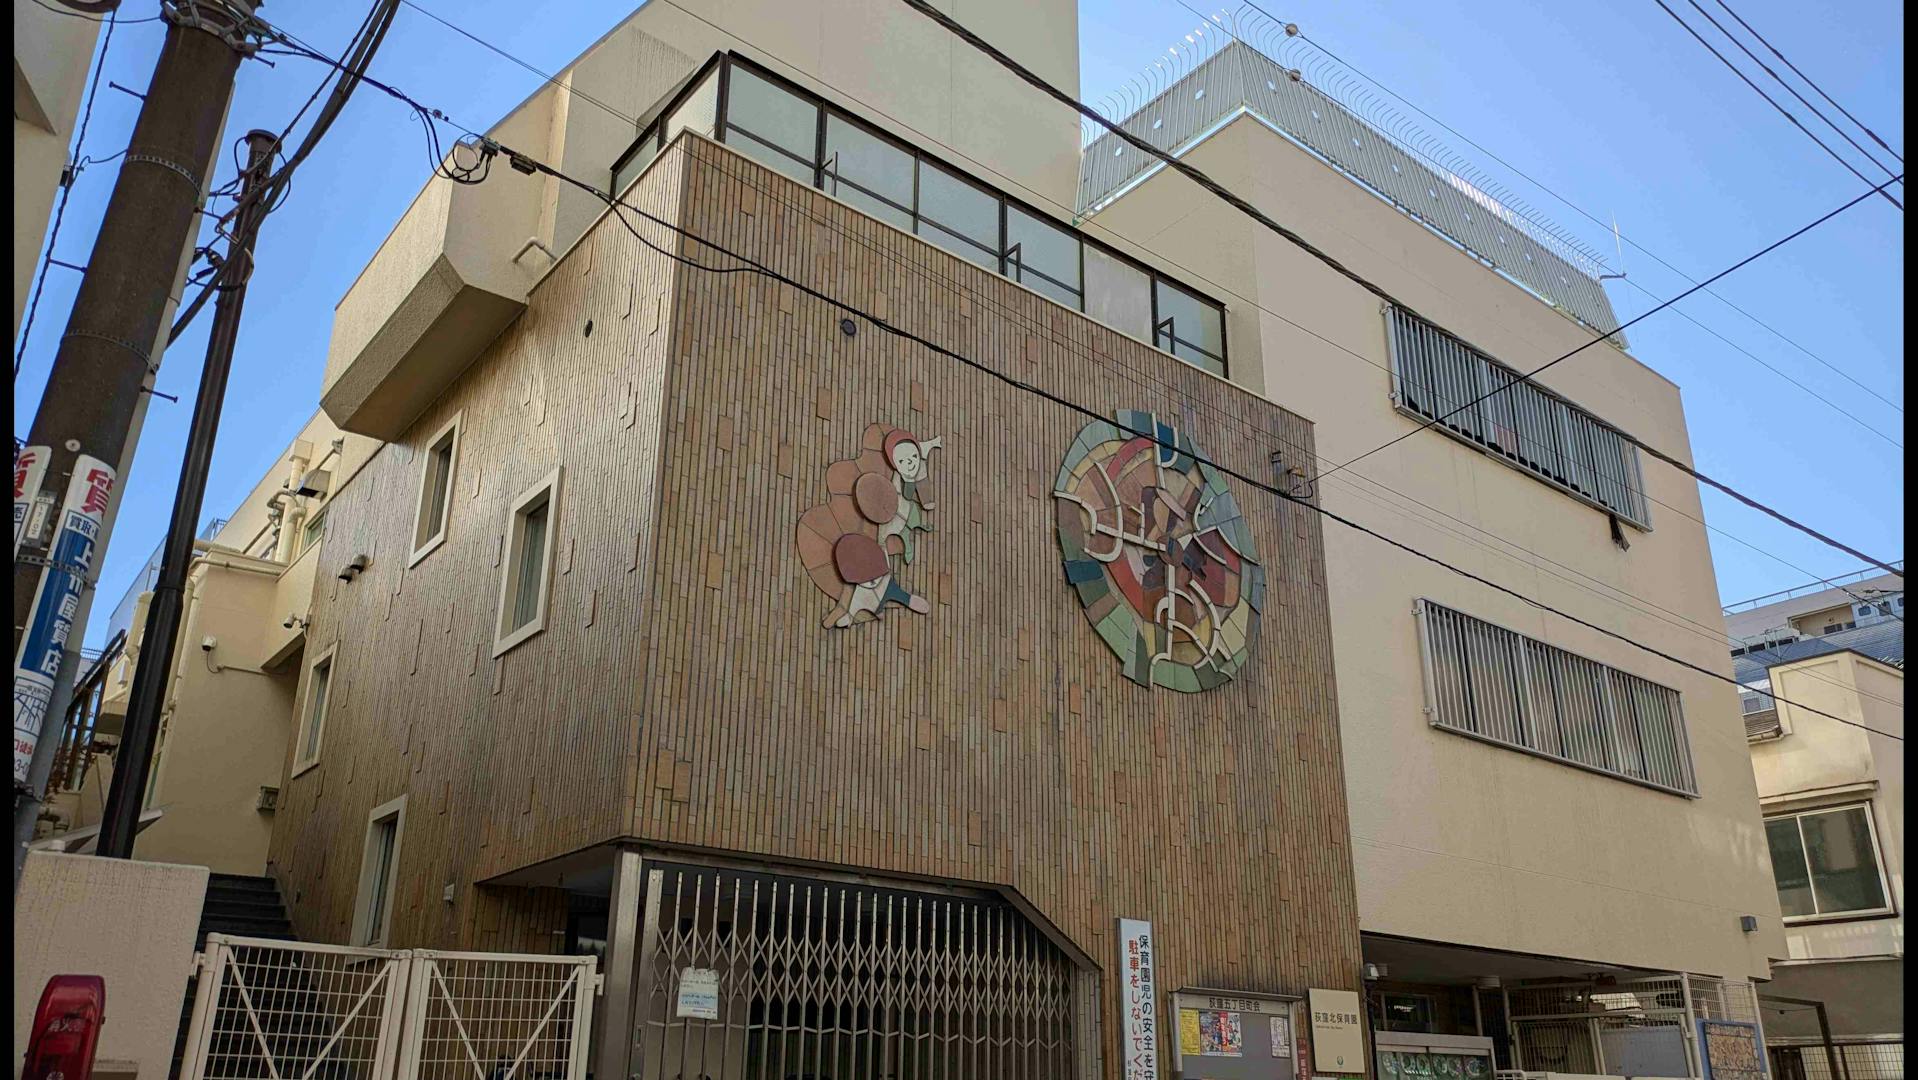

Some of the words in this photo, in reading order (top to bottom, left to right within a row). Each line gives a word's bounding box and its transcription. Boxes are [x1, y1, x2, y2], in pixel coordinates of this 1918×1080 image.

[81, 469, 115, 514] 質
[1314, 1011, 1358, 1025] 荻窪北保育園
